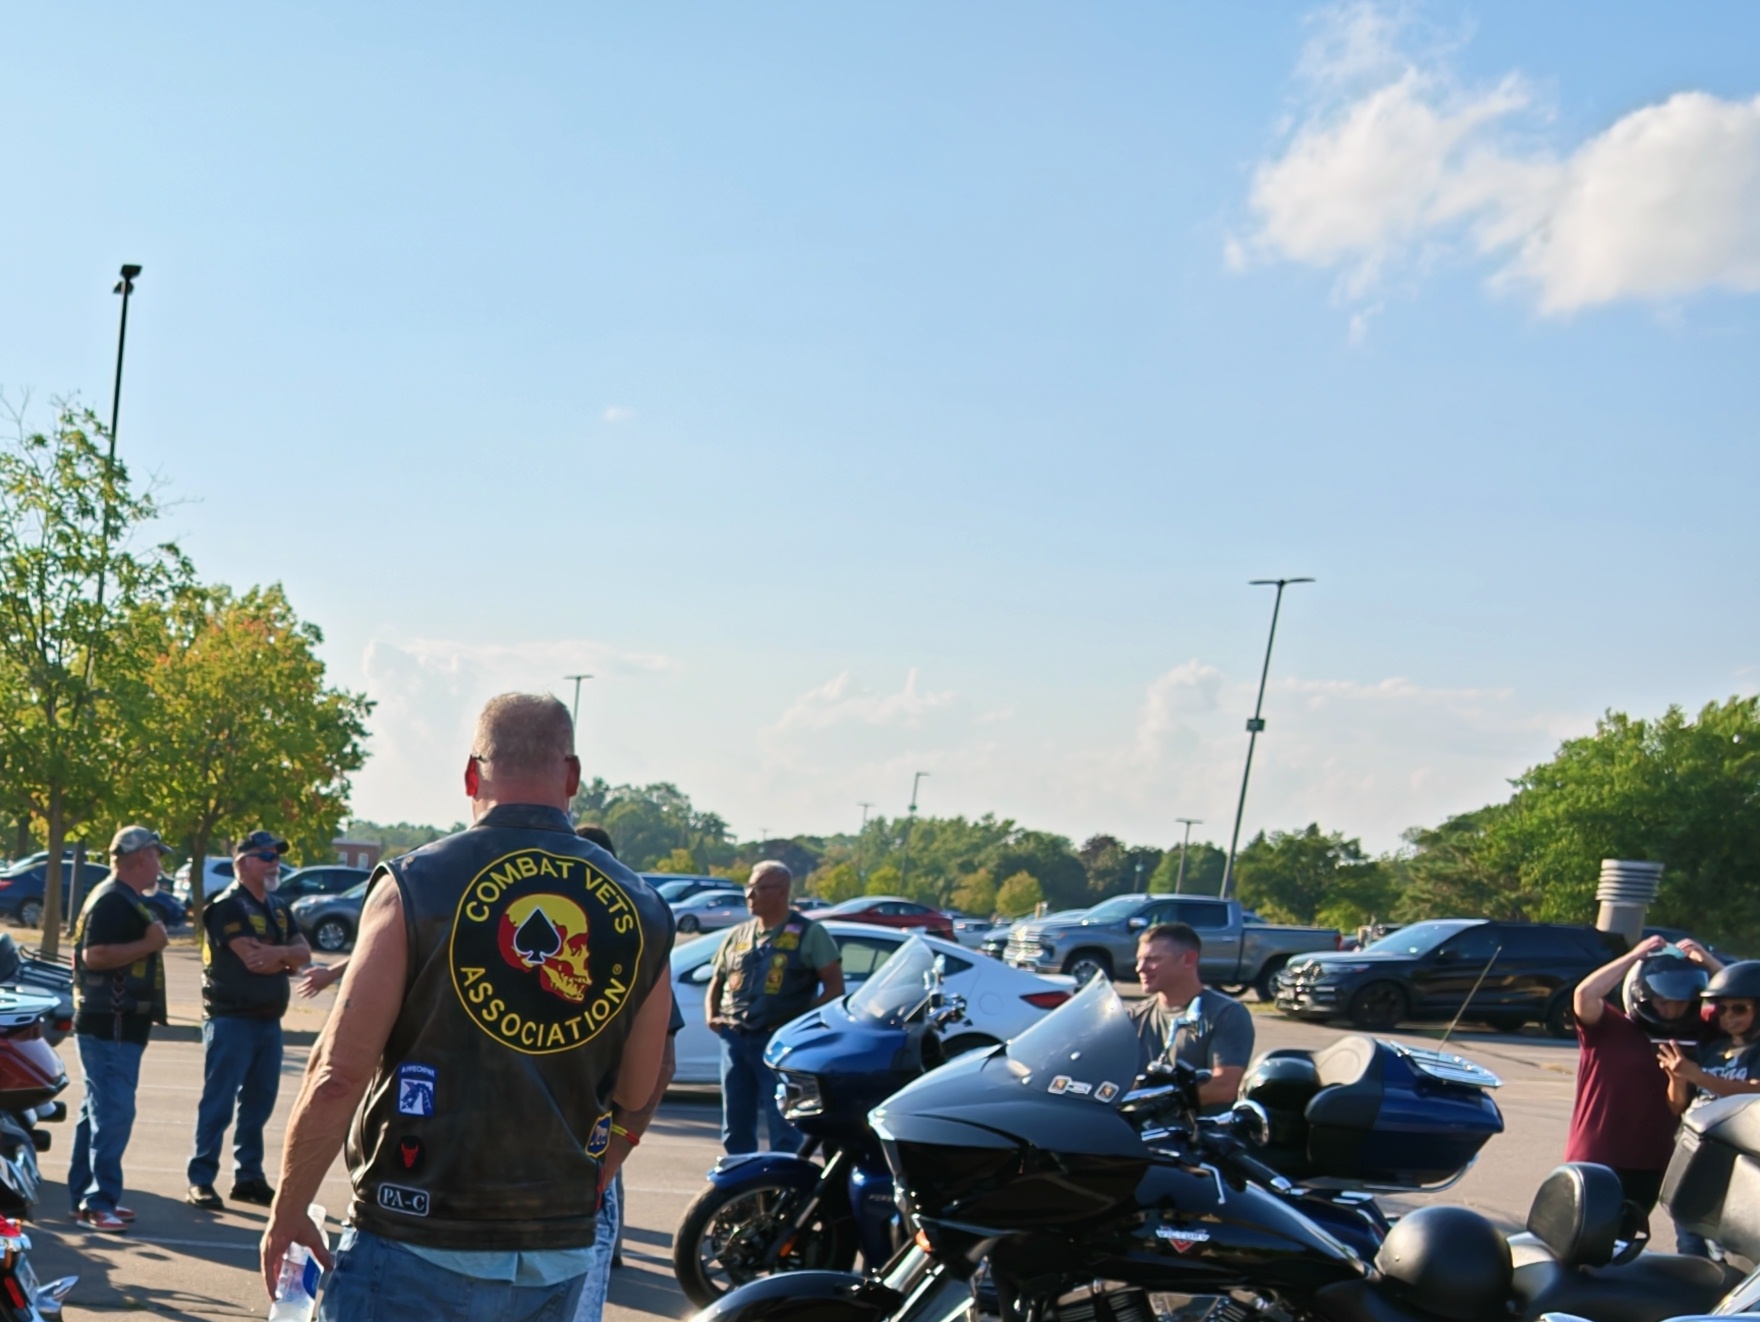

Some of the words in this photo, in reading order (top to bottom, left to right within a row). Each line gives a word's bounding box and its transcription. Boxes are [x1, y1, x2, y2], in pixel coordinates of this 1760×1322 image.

[465, 856, 575, 923] COMBAT
[585, 867, 634, 934] VETS
[460, 967, 627, 1047] ASSOCIATION
[383, 1187, 425, 1211] PA-C
